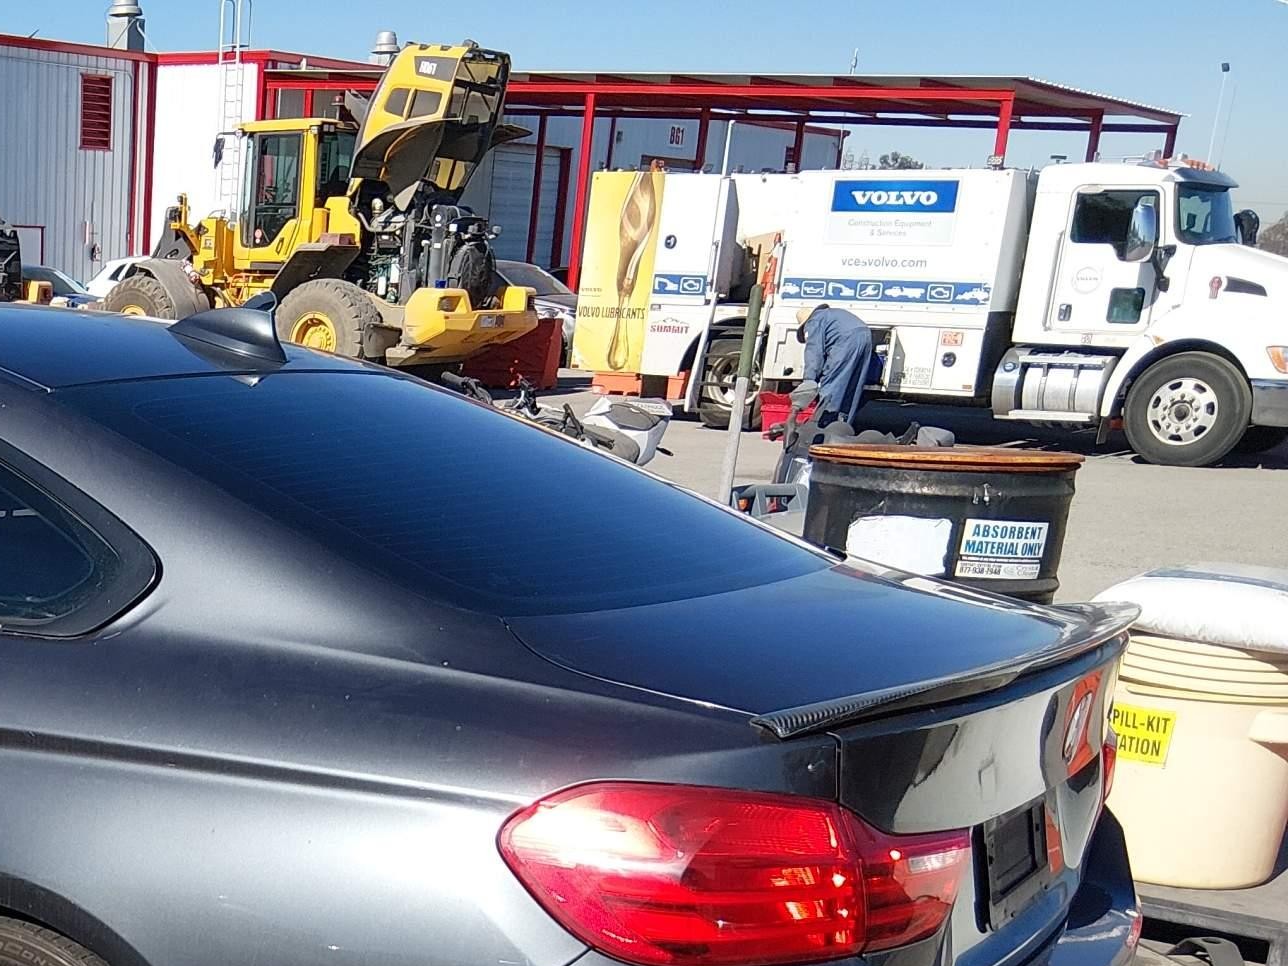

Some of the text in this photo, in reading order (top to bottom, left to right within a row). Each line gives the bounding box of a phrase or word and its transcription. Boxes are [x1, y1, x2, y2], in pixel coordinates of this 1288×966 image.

[851, 190, 939, 206] VOLVO
[847, 218, 932, 230] Construction Equipment
[877, 229, 907, 237] Services
[578, 306, 600, 318] VOLVO
[601, 306, 645, 319] LUBRICANTS
[650, 324, 690, 334] SUMMIT
[972, 524, 1044, 540] ABSORBENT
[963, 540, 1043, 556] MATERIAL ONLY
[1112, 708, 1171, 734] PILL-KIT
